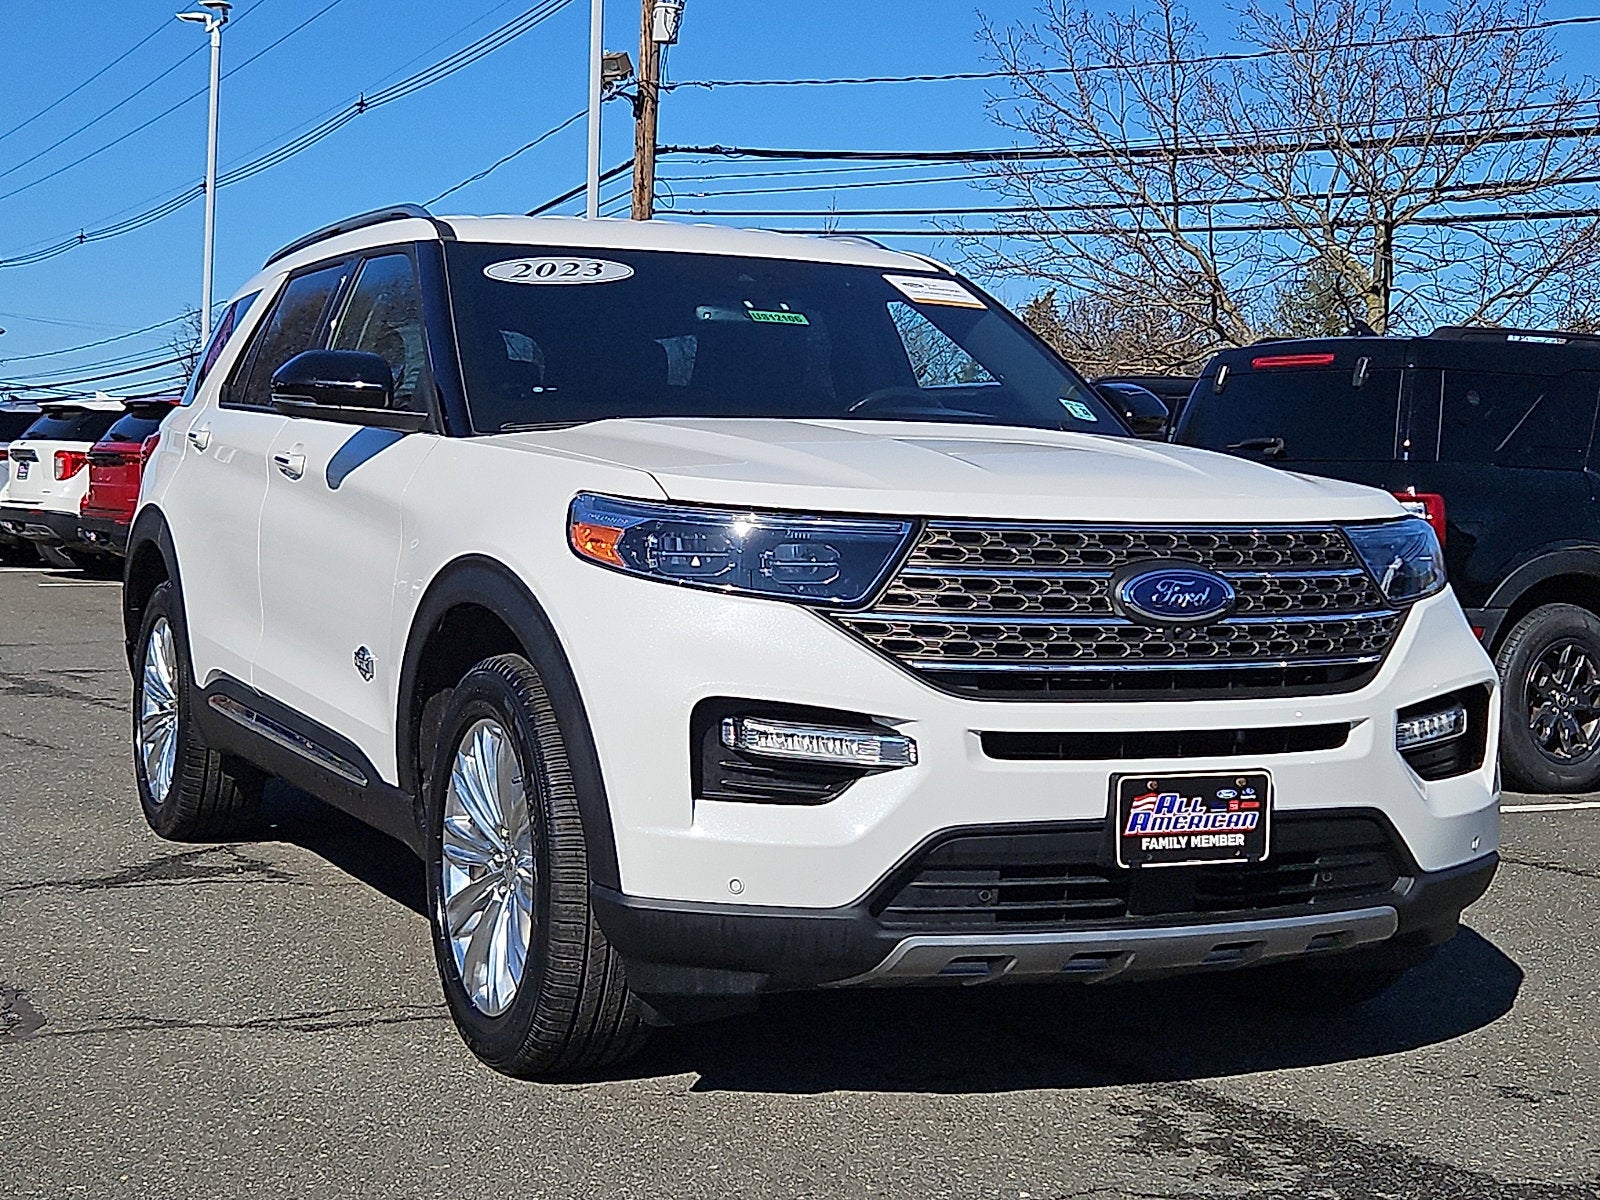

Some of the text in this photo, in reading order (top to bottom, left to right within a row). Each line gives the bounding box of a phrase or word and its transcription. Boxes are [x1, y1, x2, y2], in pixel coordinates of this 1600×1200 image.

[510, 262, 604, 278] 2023
[1152, 579, 1211, 607] Ford
[1154, 793, 1207, 815] ALL
[1126, 810, 1259, 832] AMERICAN
[1141, 834, 1245, 850] FAMILY MEMBER
